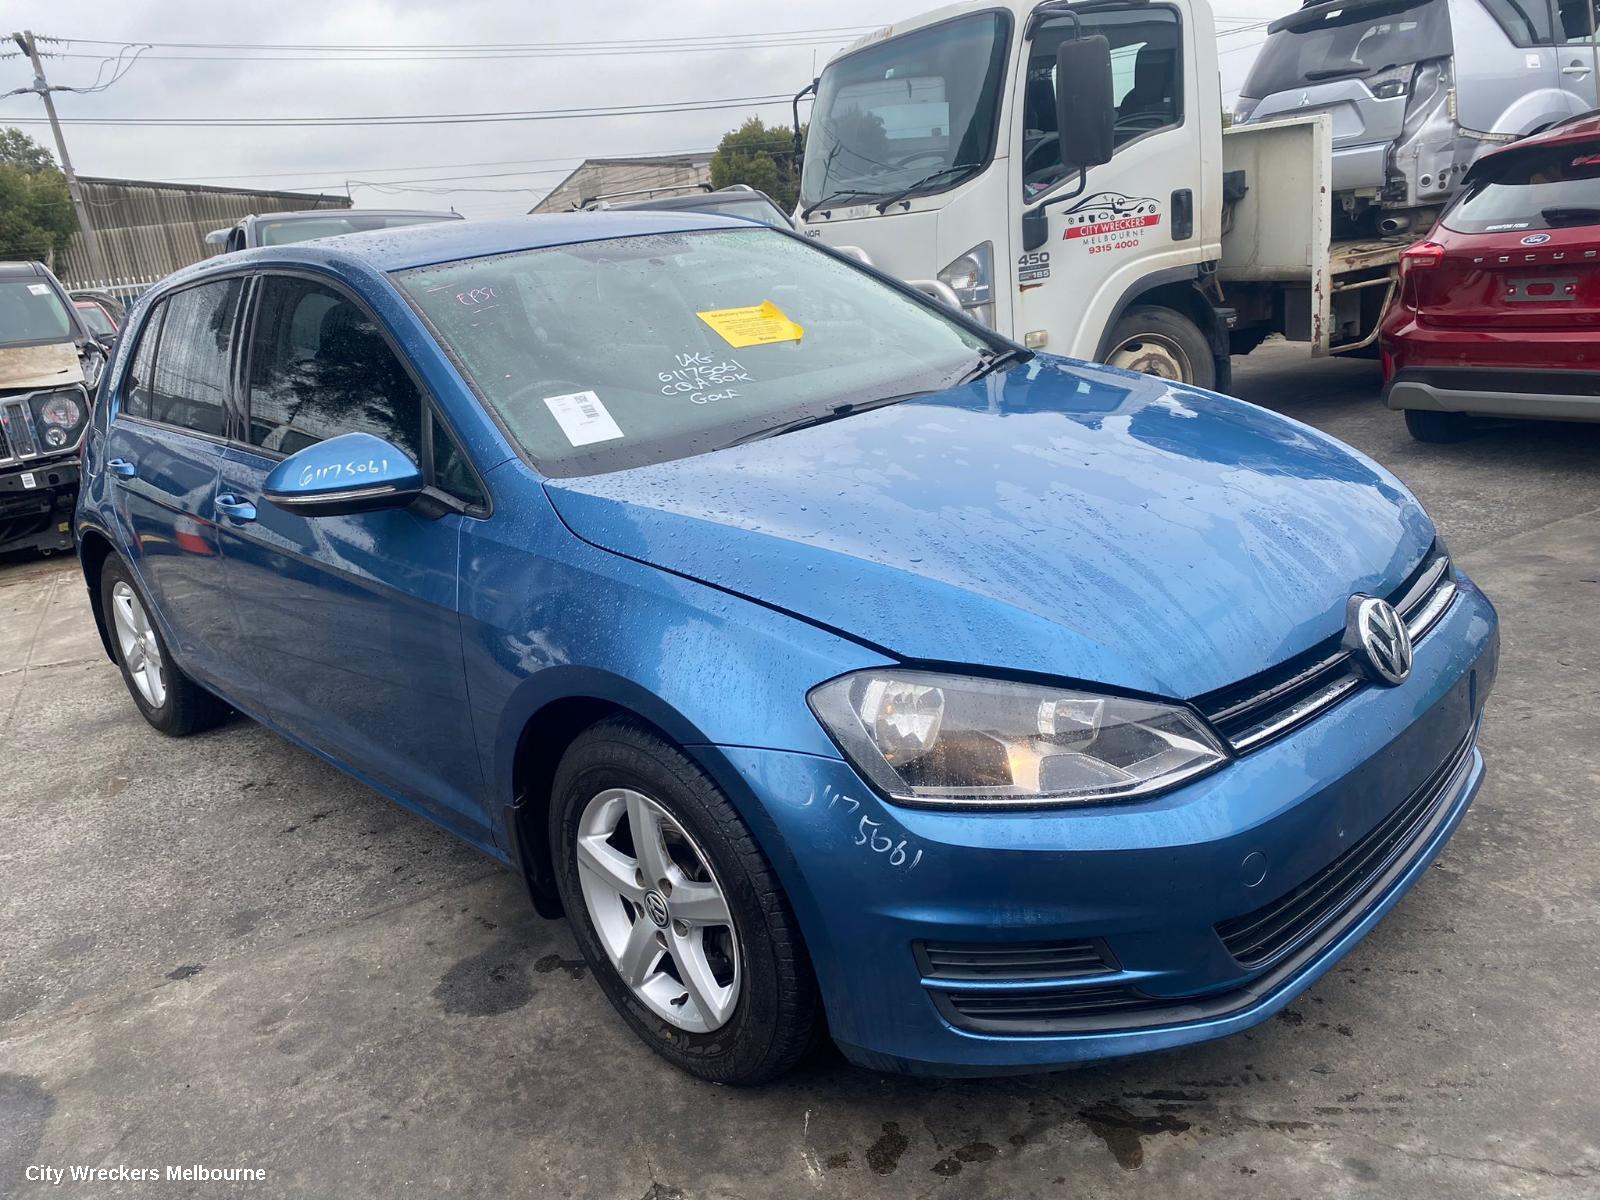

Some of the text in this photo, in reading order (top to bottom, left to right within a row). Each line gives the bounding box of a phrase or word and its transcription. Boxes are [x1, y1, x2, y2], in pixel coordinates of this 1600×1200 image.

[1080, 216, 1146, 236] CITY WRECKERS
[1083, 229, 1145, 245] MELBOURNE
[1088, 239, 1139, 254] 9315 4000
[1018, 252, 1050, 265] 450
